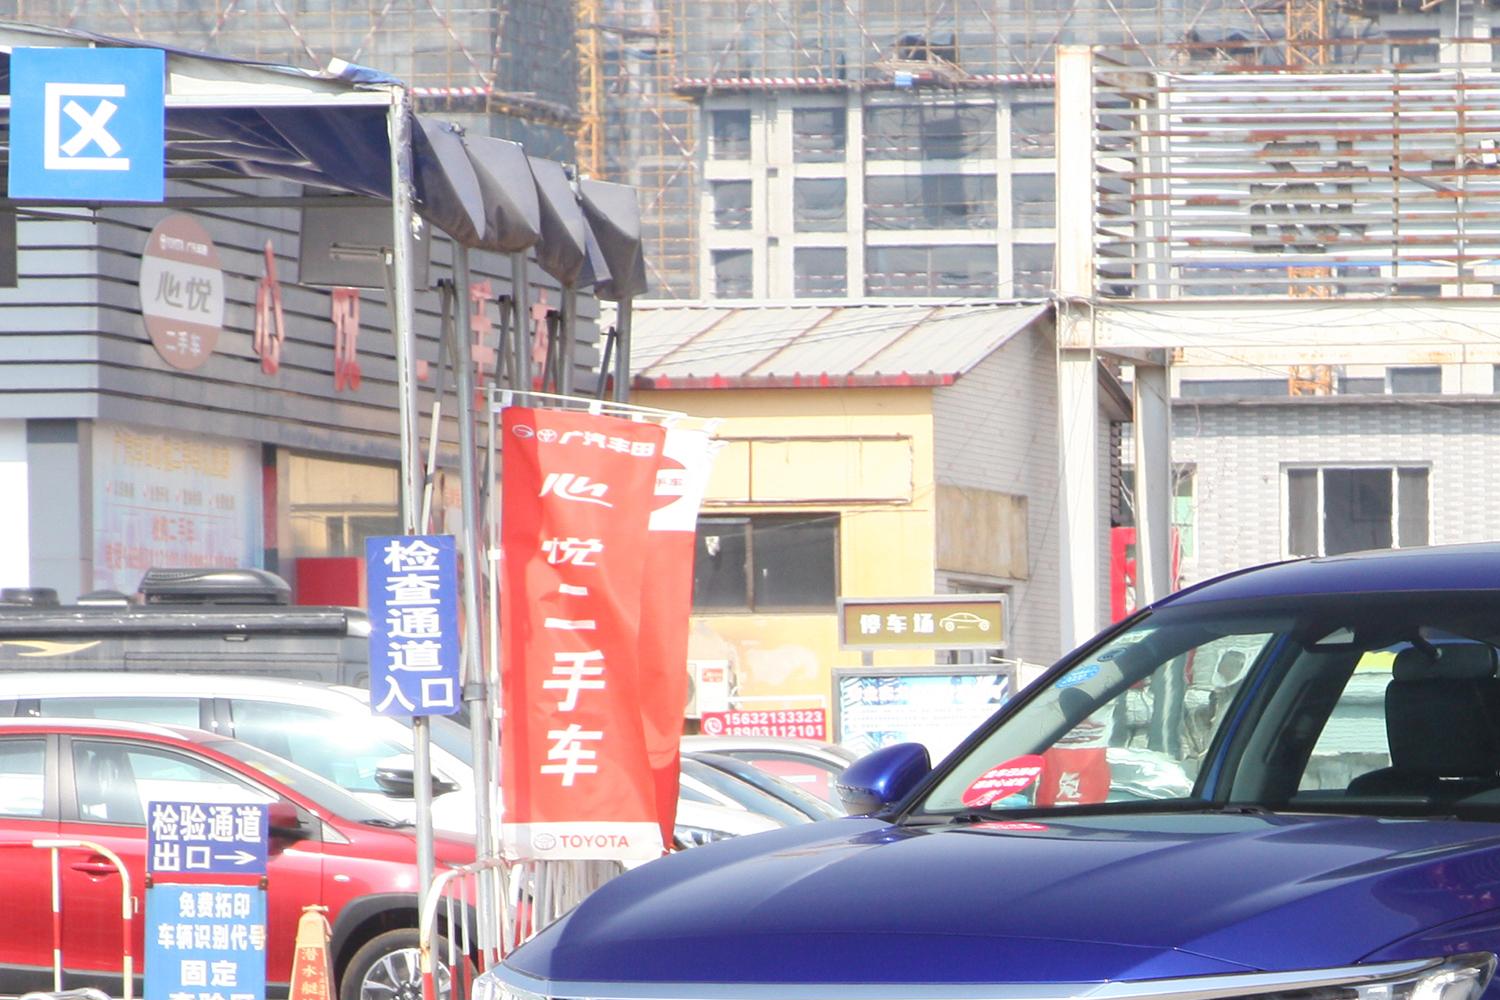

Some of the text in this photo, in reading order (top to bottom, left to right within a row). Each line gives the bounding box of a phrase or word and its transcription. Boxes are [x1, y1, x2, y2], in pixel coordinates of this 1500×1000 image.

[44, 82, 130, 171] 区
[558, 430, 657, 457] 广汽丰田
[384, 540, 443, 671] 检查通道
[538, 473, 613, 787] 心悦二手车
[860, 612, 934, 635] 停车场
[375, 675, 454, 712] 入口
[723, 711, 823, 725] 15632133323
[723, 725, 823, 738] 18903112101
[152, 804, 262, 843] 检验通道
[560, 834, 629, 849] TOYOTA
[153, 842, 211, 872] 出口
[178, 892, 250, 919] 免费拓印
[158, 924, 266, 950] 车辆识别代号
[180, 960, 238, 987] 固定
